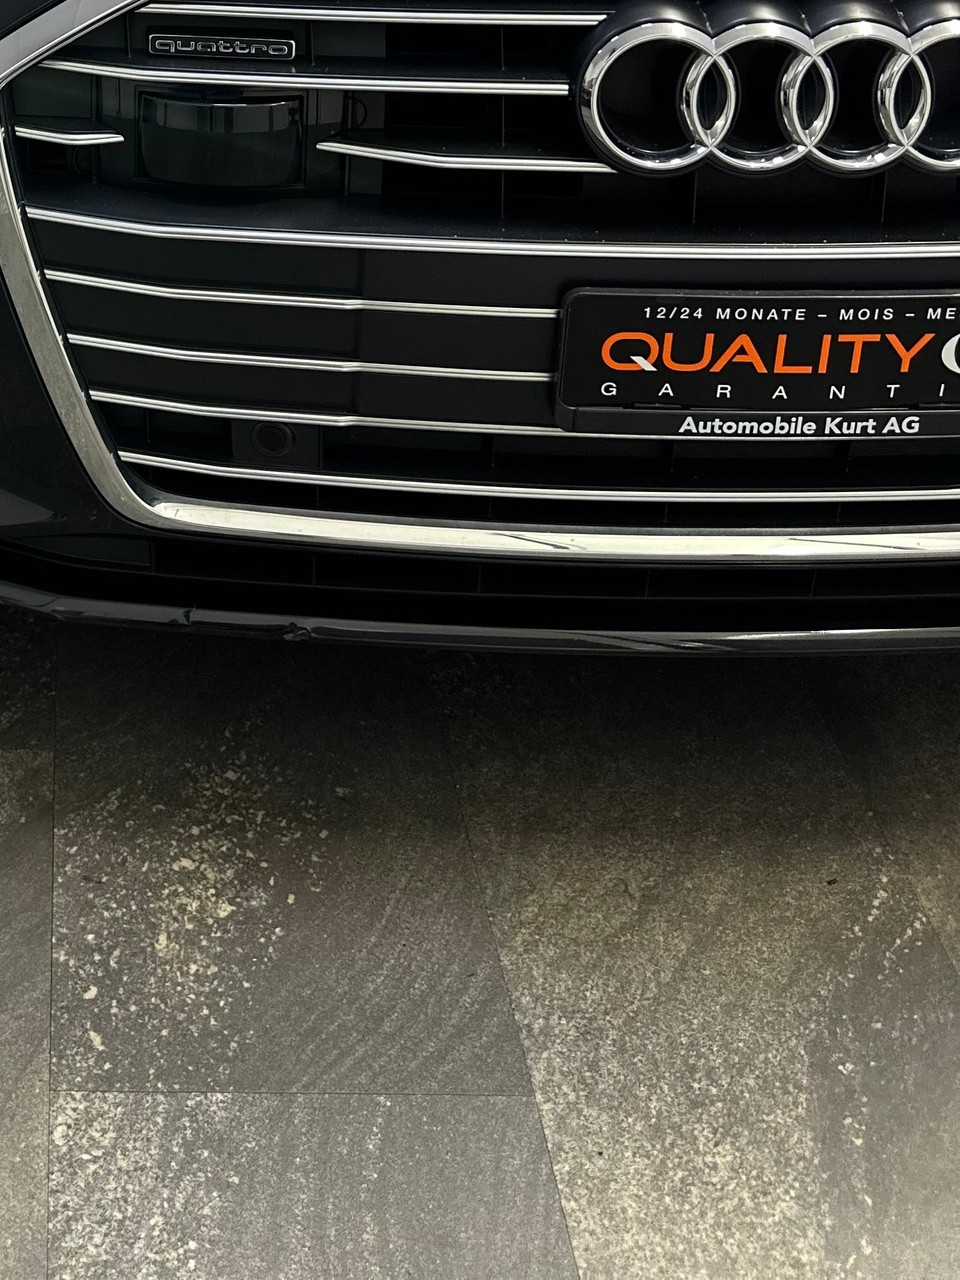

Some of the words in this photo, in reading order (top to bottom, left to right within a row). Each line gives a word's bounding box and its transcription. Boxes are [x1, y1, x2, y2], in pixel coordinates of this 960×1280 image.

[155, 38, 289, 55] quattro
[643, 306, 703, 319] 12/24
[715, 307, 806, 321] MONATE
[839, 308, 894, 321] MOIS
[926, 307, 960, 320] ME
[678, 416, 817, 435] Automobile
[824, 416, 877, 435] Kurt
[881, 415, 920, 434] AG
